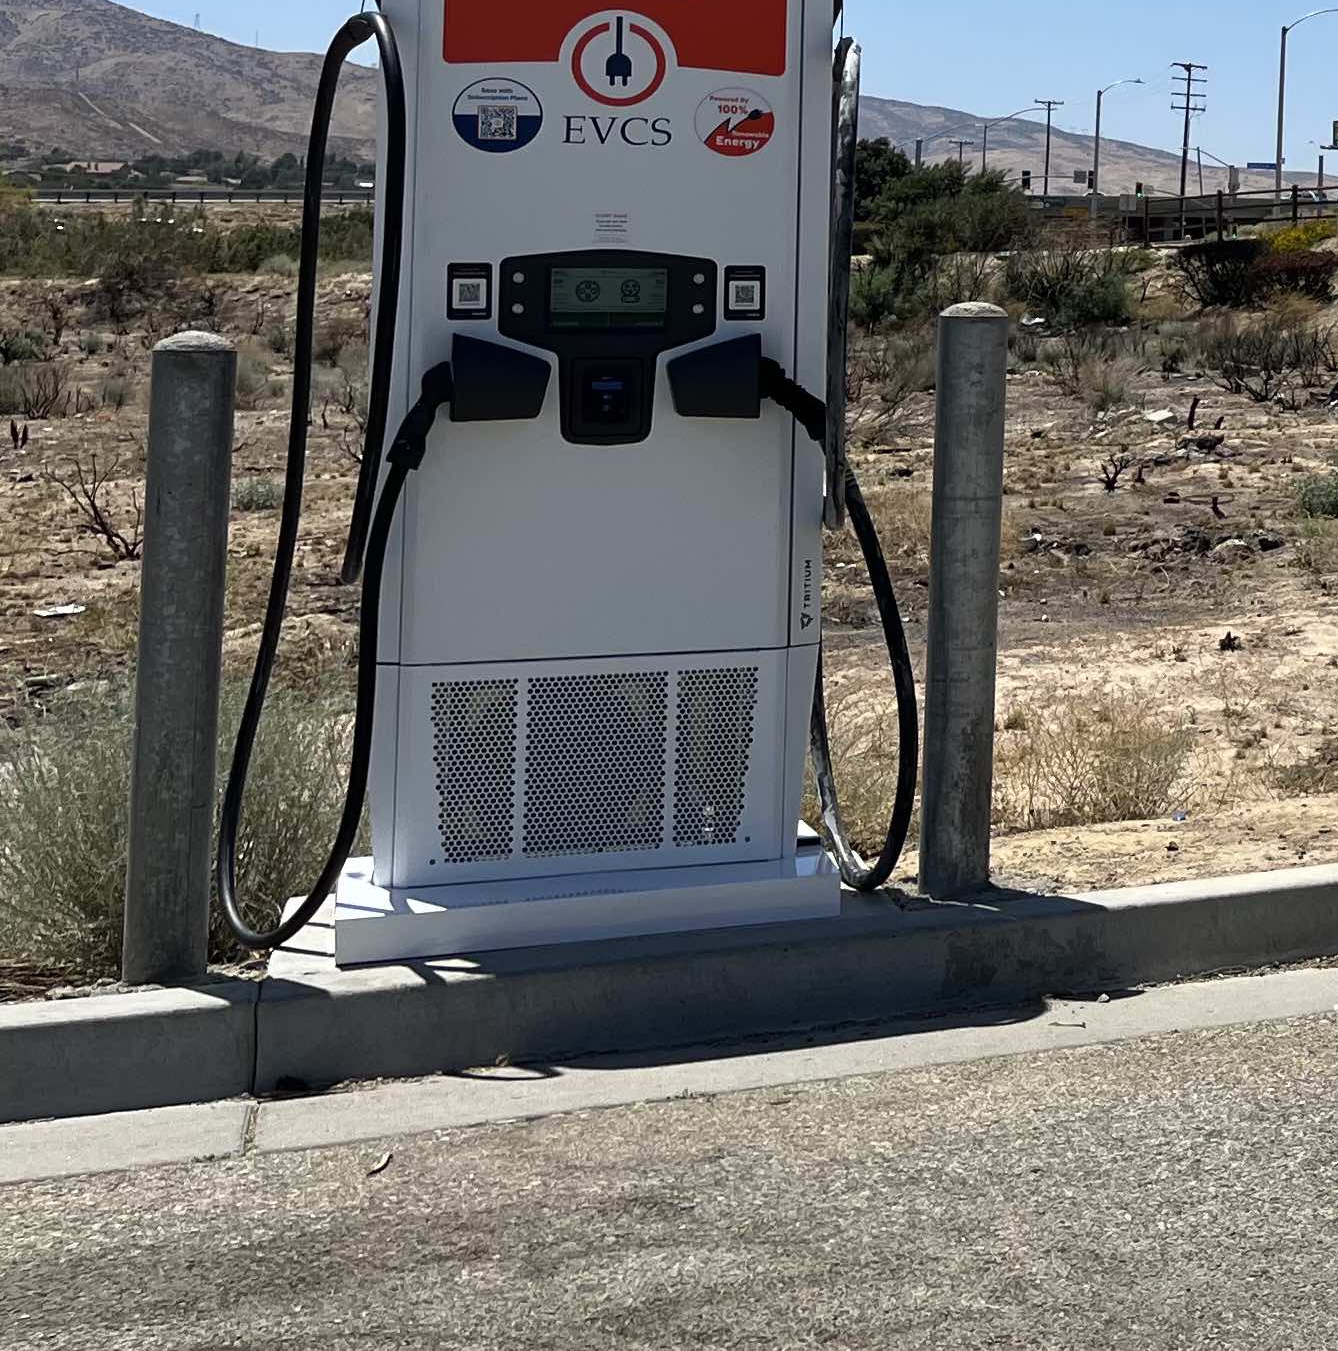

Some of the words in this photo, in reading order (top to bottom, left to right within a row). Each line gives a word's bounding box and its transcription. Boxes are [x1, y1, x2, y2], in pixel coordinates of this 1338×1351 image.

[718, 104, 748, 115] 100%
[561, 115, 673, 147] EVCS
[715, 135, 760, 149] Energy
[803, 559, 813, 608] TRITIUM
